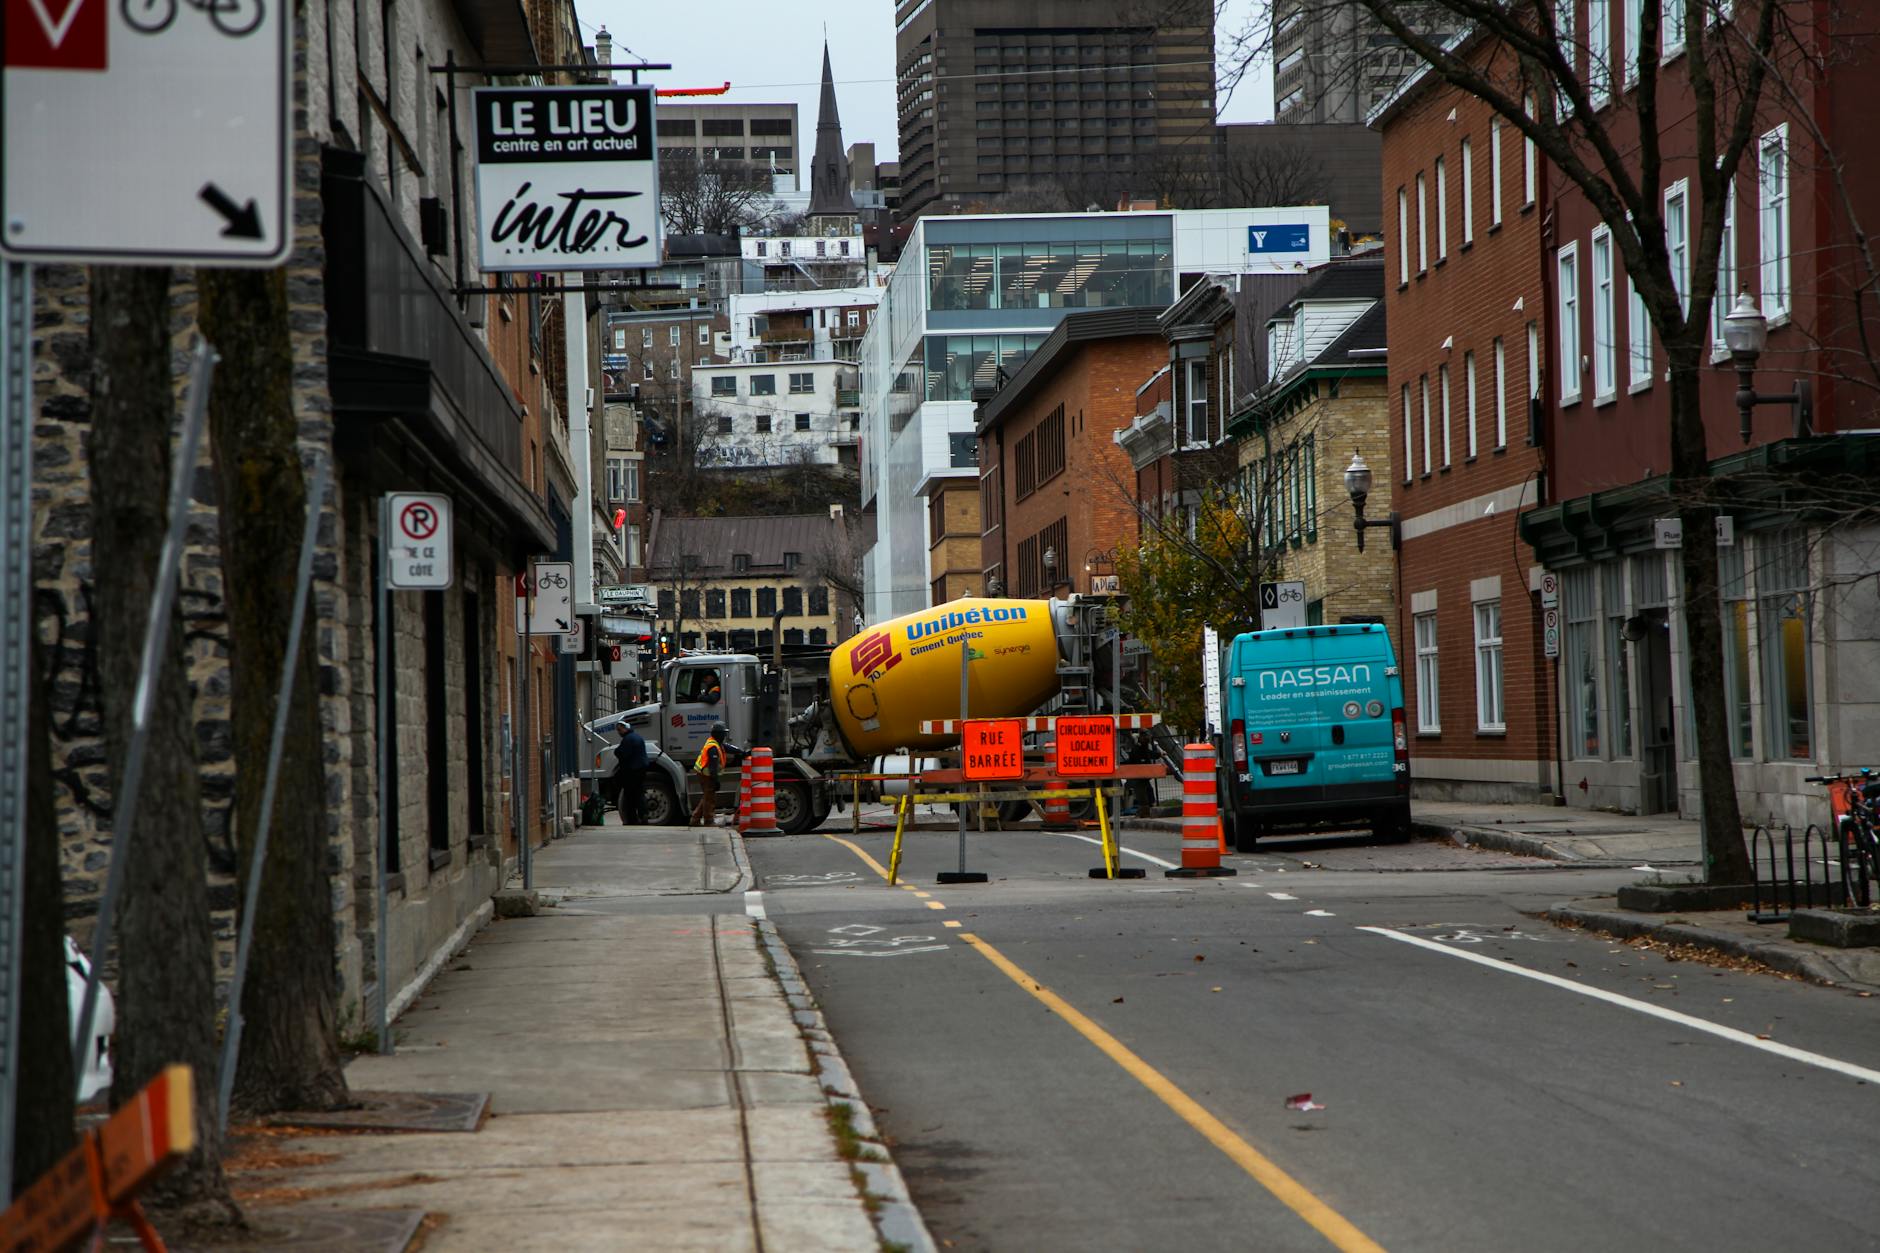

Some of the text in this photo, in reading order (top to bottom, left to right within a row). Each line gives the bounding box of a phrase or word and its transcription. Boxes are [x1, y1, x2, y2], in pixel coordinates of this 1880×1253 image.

[491, 99, 637, 135] LE LIEU
[493, 135, 638, 153] centre en art actuel
[491, 181, 649, 254] inter
[906, 606, 1027, 641] Unibéton
[910, 630, 984, 656] Ciment Québec
[1260, 664, 1371, 689] NASSAN
[1260, 692, 1291, 701] Leader
[1305, 687, 1372, 698] assainissement
[980, 732, 1004, 745] RUE
[1060, 724, 1111, 736] CIRCULATION
[1071, 740, 1100, 751] LOCALE
[970, 751, 1017, 768] BARRÉE
[1063, 756, 1109, 767] SEULEMENT
